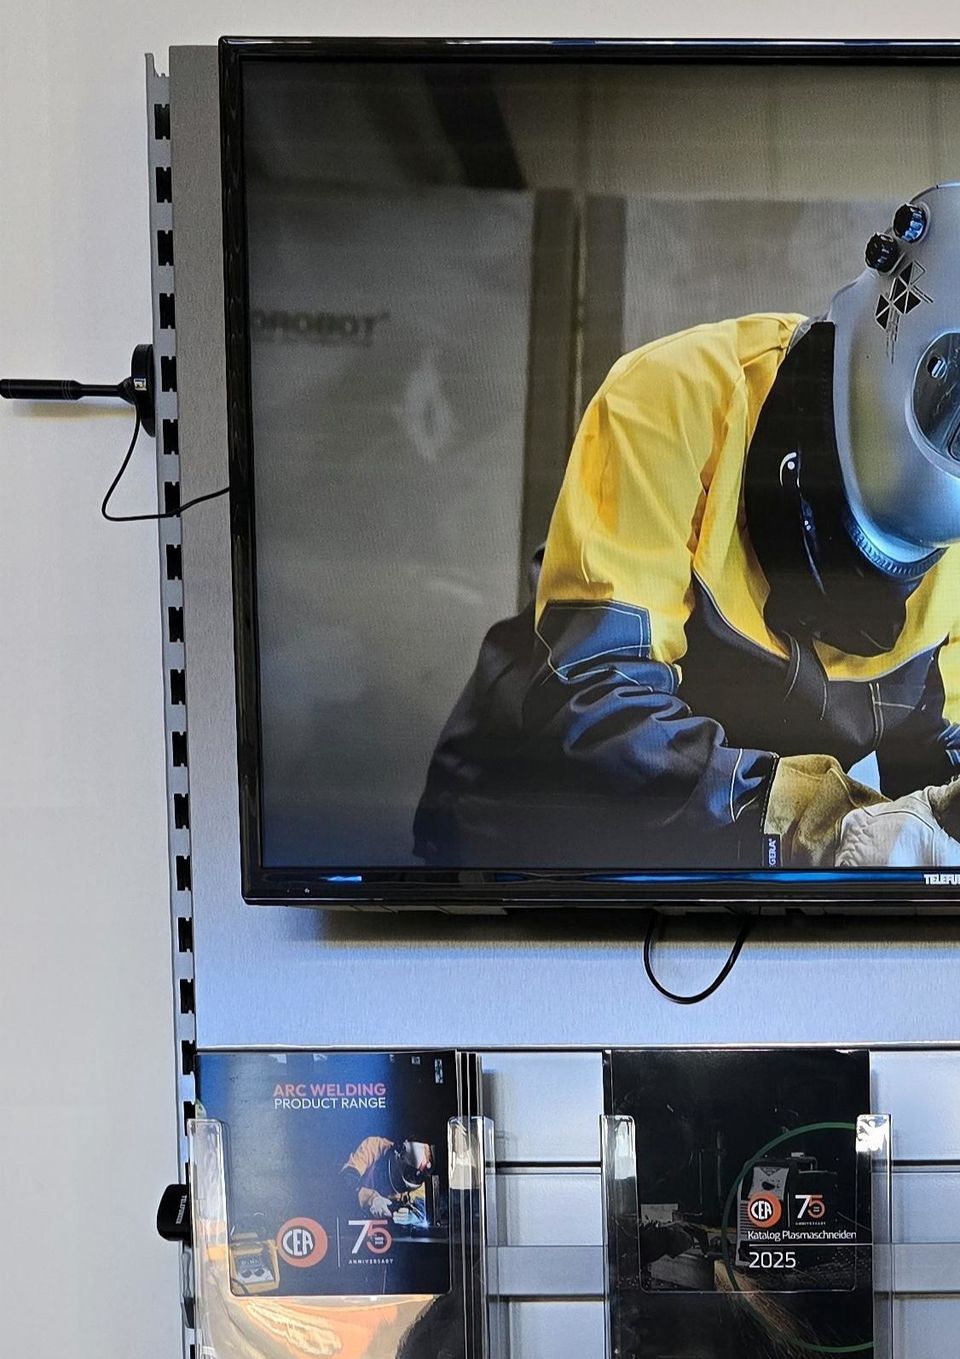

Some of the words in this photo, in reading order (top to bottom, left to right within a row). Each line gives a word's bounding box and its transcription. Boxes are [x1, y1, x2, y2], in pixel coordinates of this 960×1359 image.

[272, 1084, 306, 1097] ARC
[312, 1083, 386, 1097] WELDING
[274, 1097, 336, 1109] PRODUCT
[341, 1097, 386, 1108] RANGE
[751, 1201, 772, 1220] CEA
[795, 1194, 825, 1219] 75
[282, 1228, 314, 1256] CEA
[348, 1219, 393, 1254] 75
[748, 1230, 781, 1242] Katalog
[782, 1230, 857, 1240] Plasmaschneiden
[749, 1252, 796, 1268] 2025
